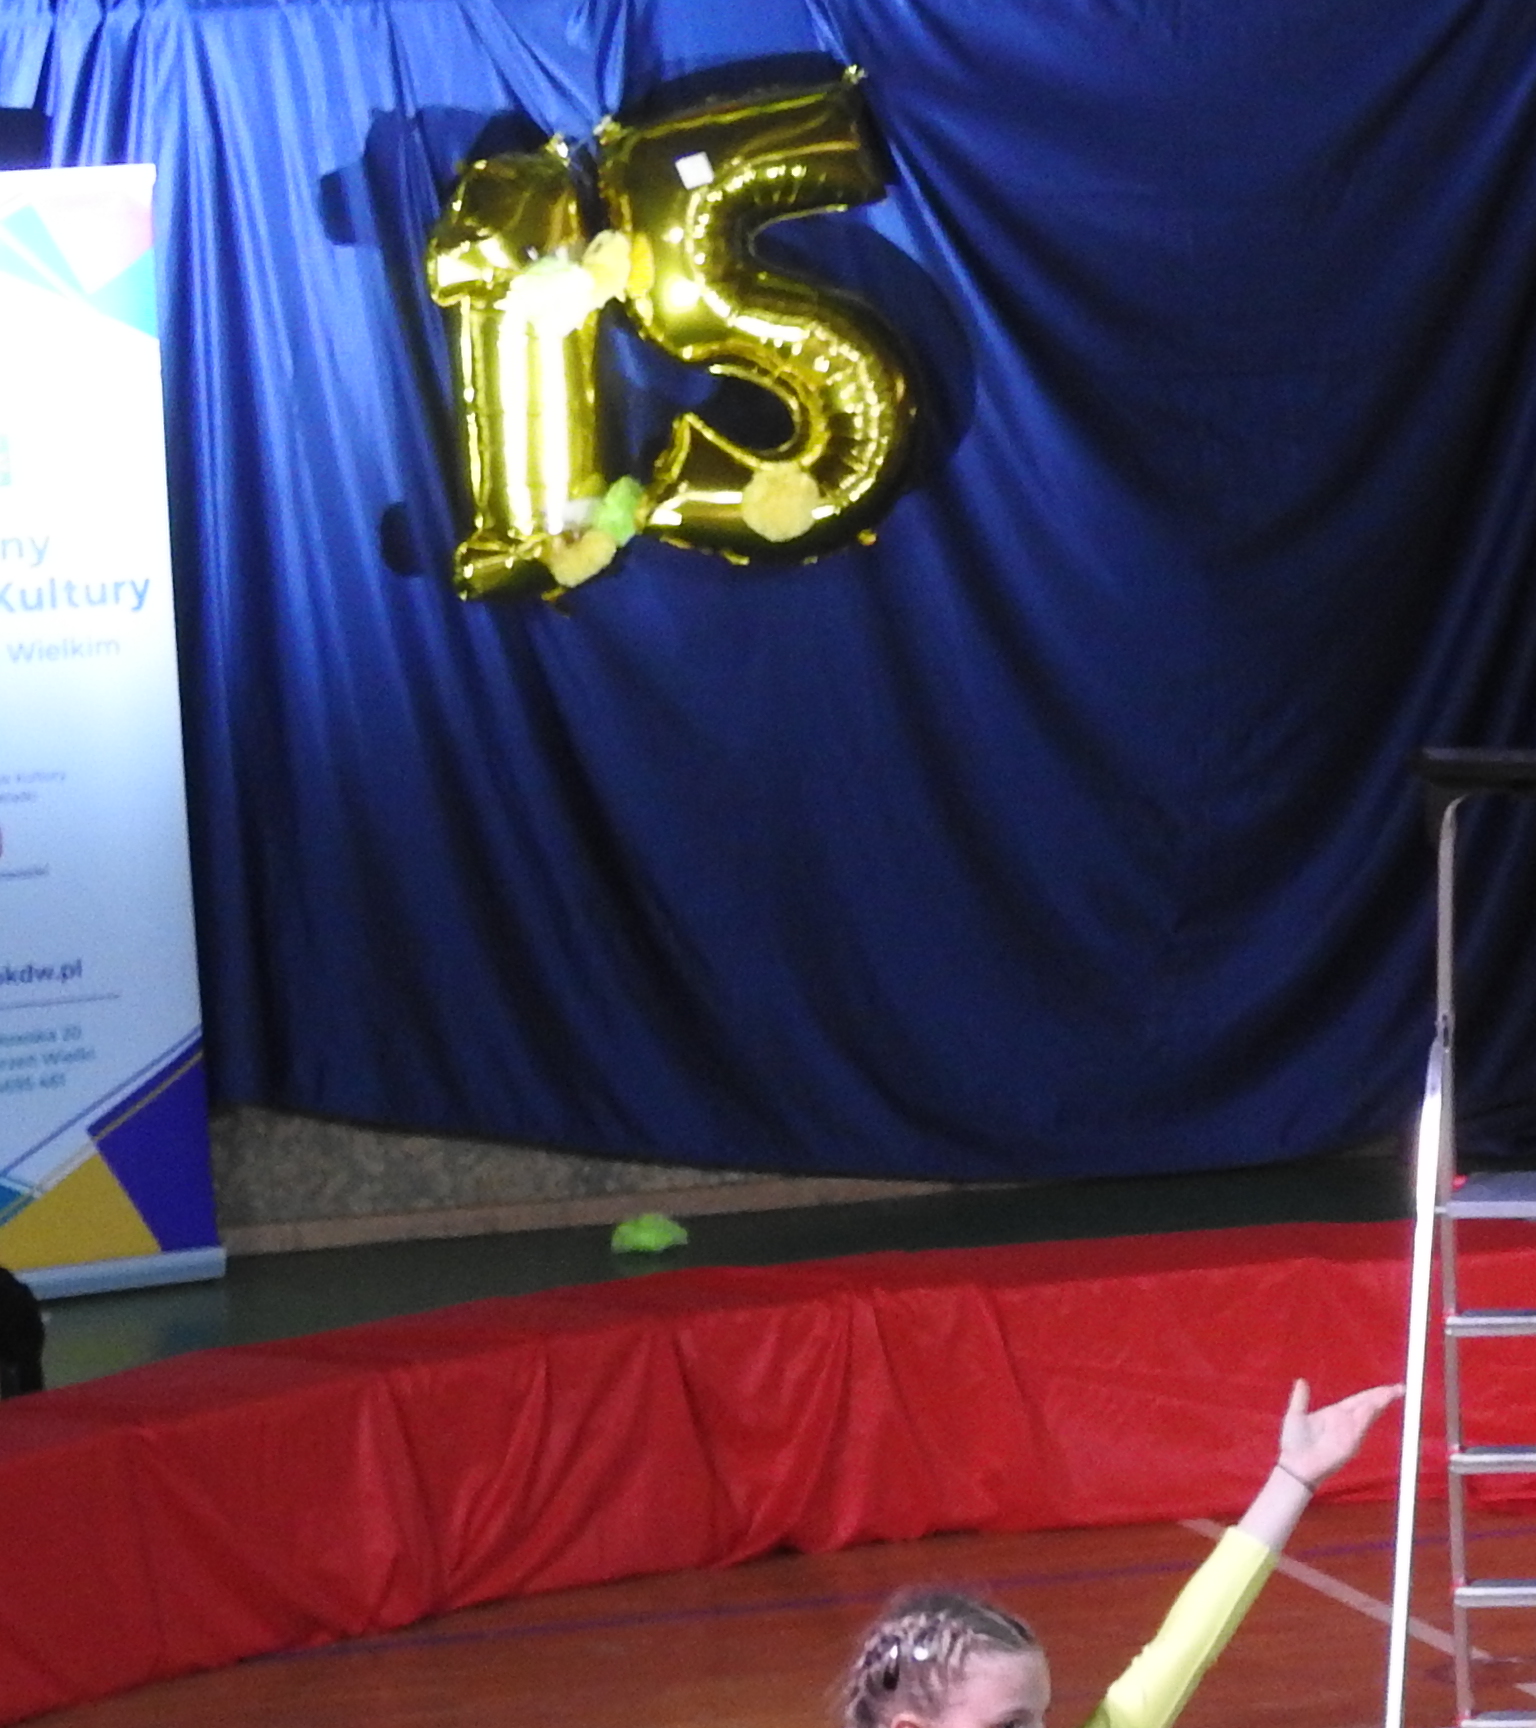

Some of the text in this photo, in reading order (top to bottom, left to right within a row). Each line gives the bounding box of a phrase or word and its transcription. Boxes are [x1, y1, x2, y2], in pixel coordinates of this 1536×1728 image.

[427, 63, 919, 601] 15
[0, 577, 150, 614] Kultury
[7, 638, 121, 664] Wielkim
